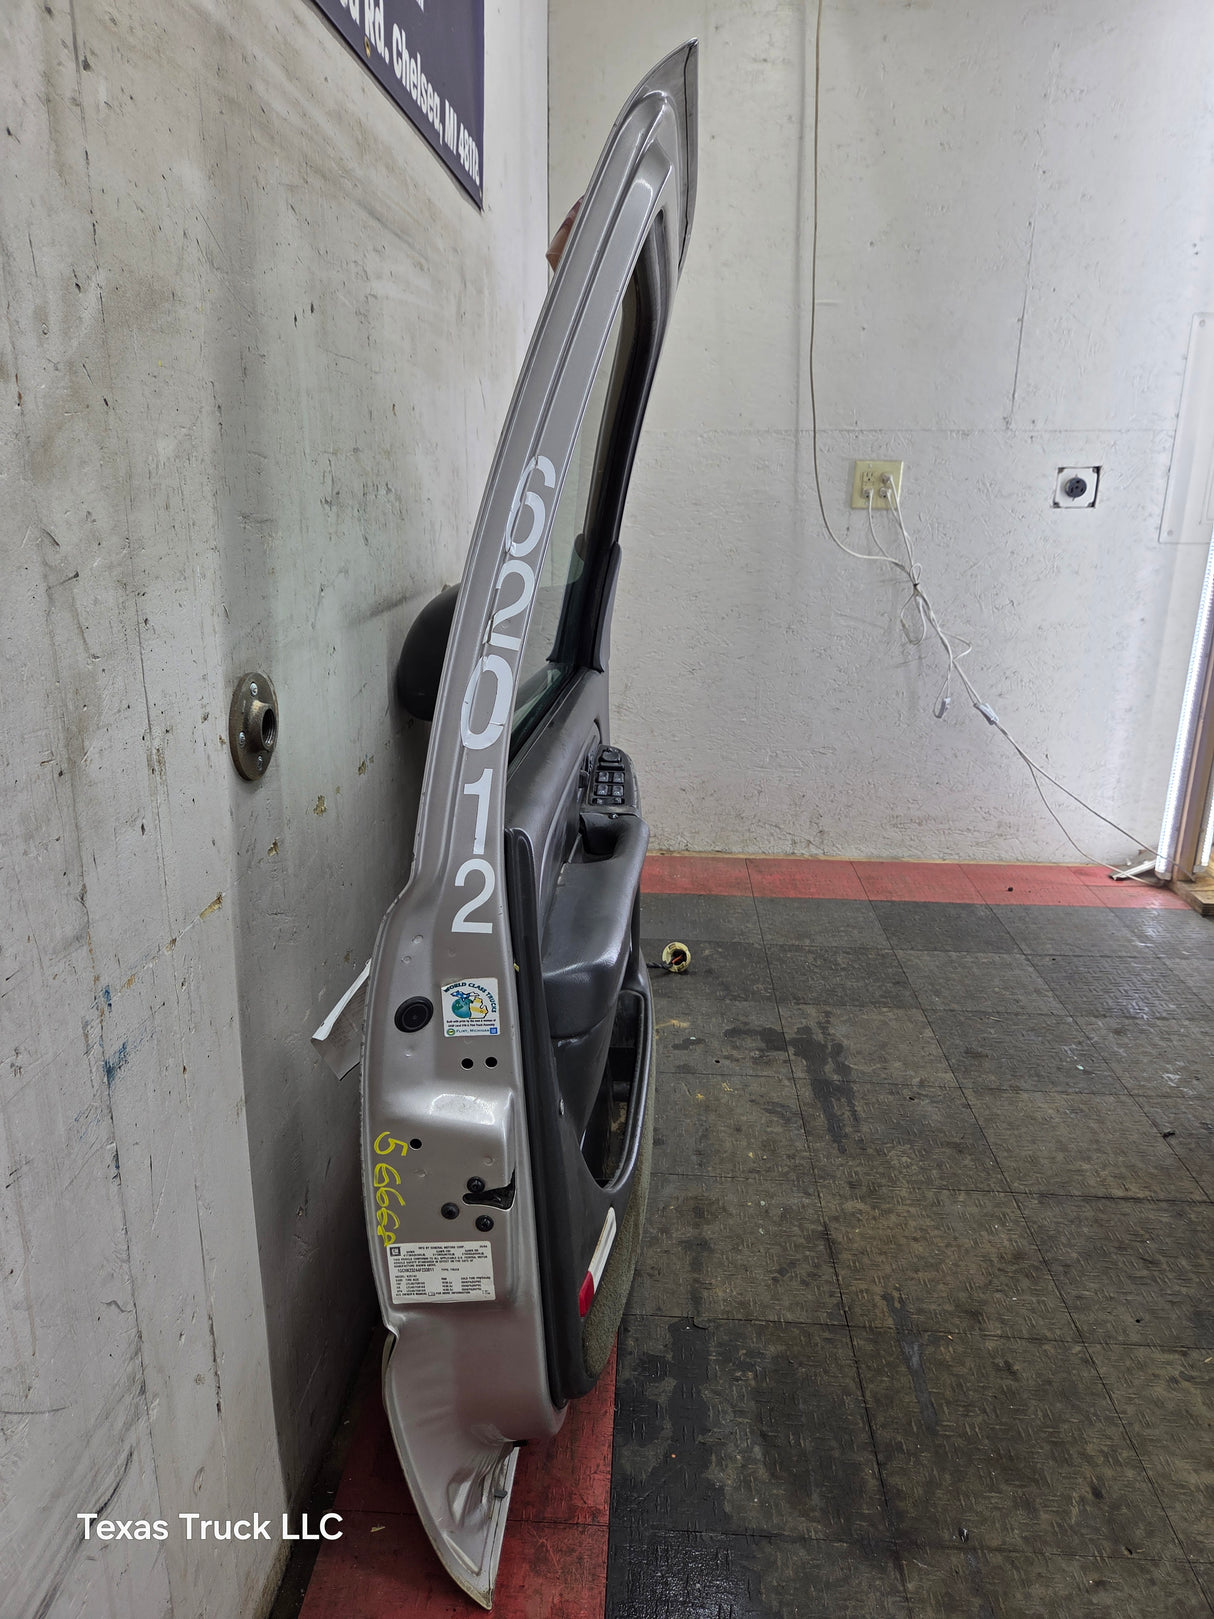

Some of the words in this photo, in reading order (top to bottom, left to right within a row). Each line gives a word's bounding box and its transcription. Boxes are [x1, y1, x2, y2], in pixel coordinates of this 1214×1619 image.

[364, 0, 390, 64] Rd.
[392, 23, 443, 145] Chelsea,
[444, 98, 458, 156] MI
[451, 454, 557, 935] 62012
[443, 982, 467, 993] WORLD
[468, 982, 487, 993] CLASS
